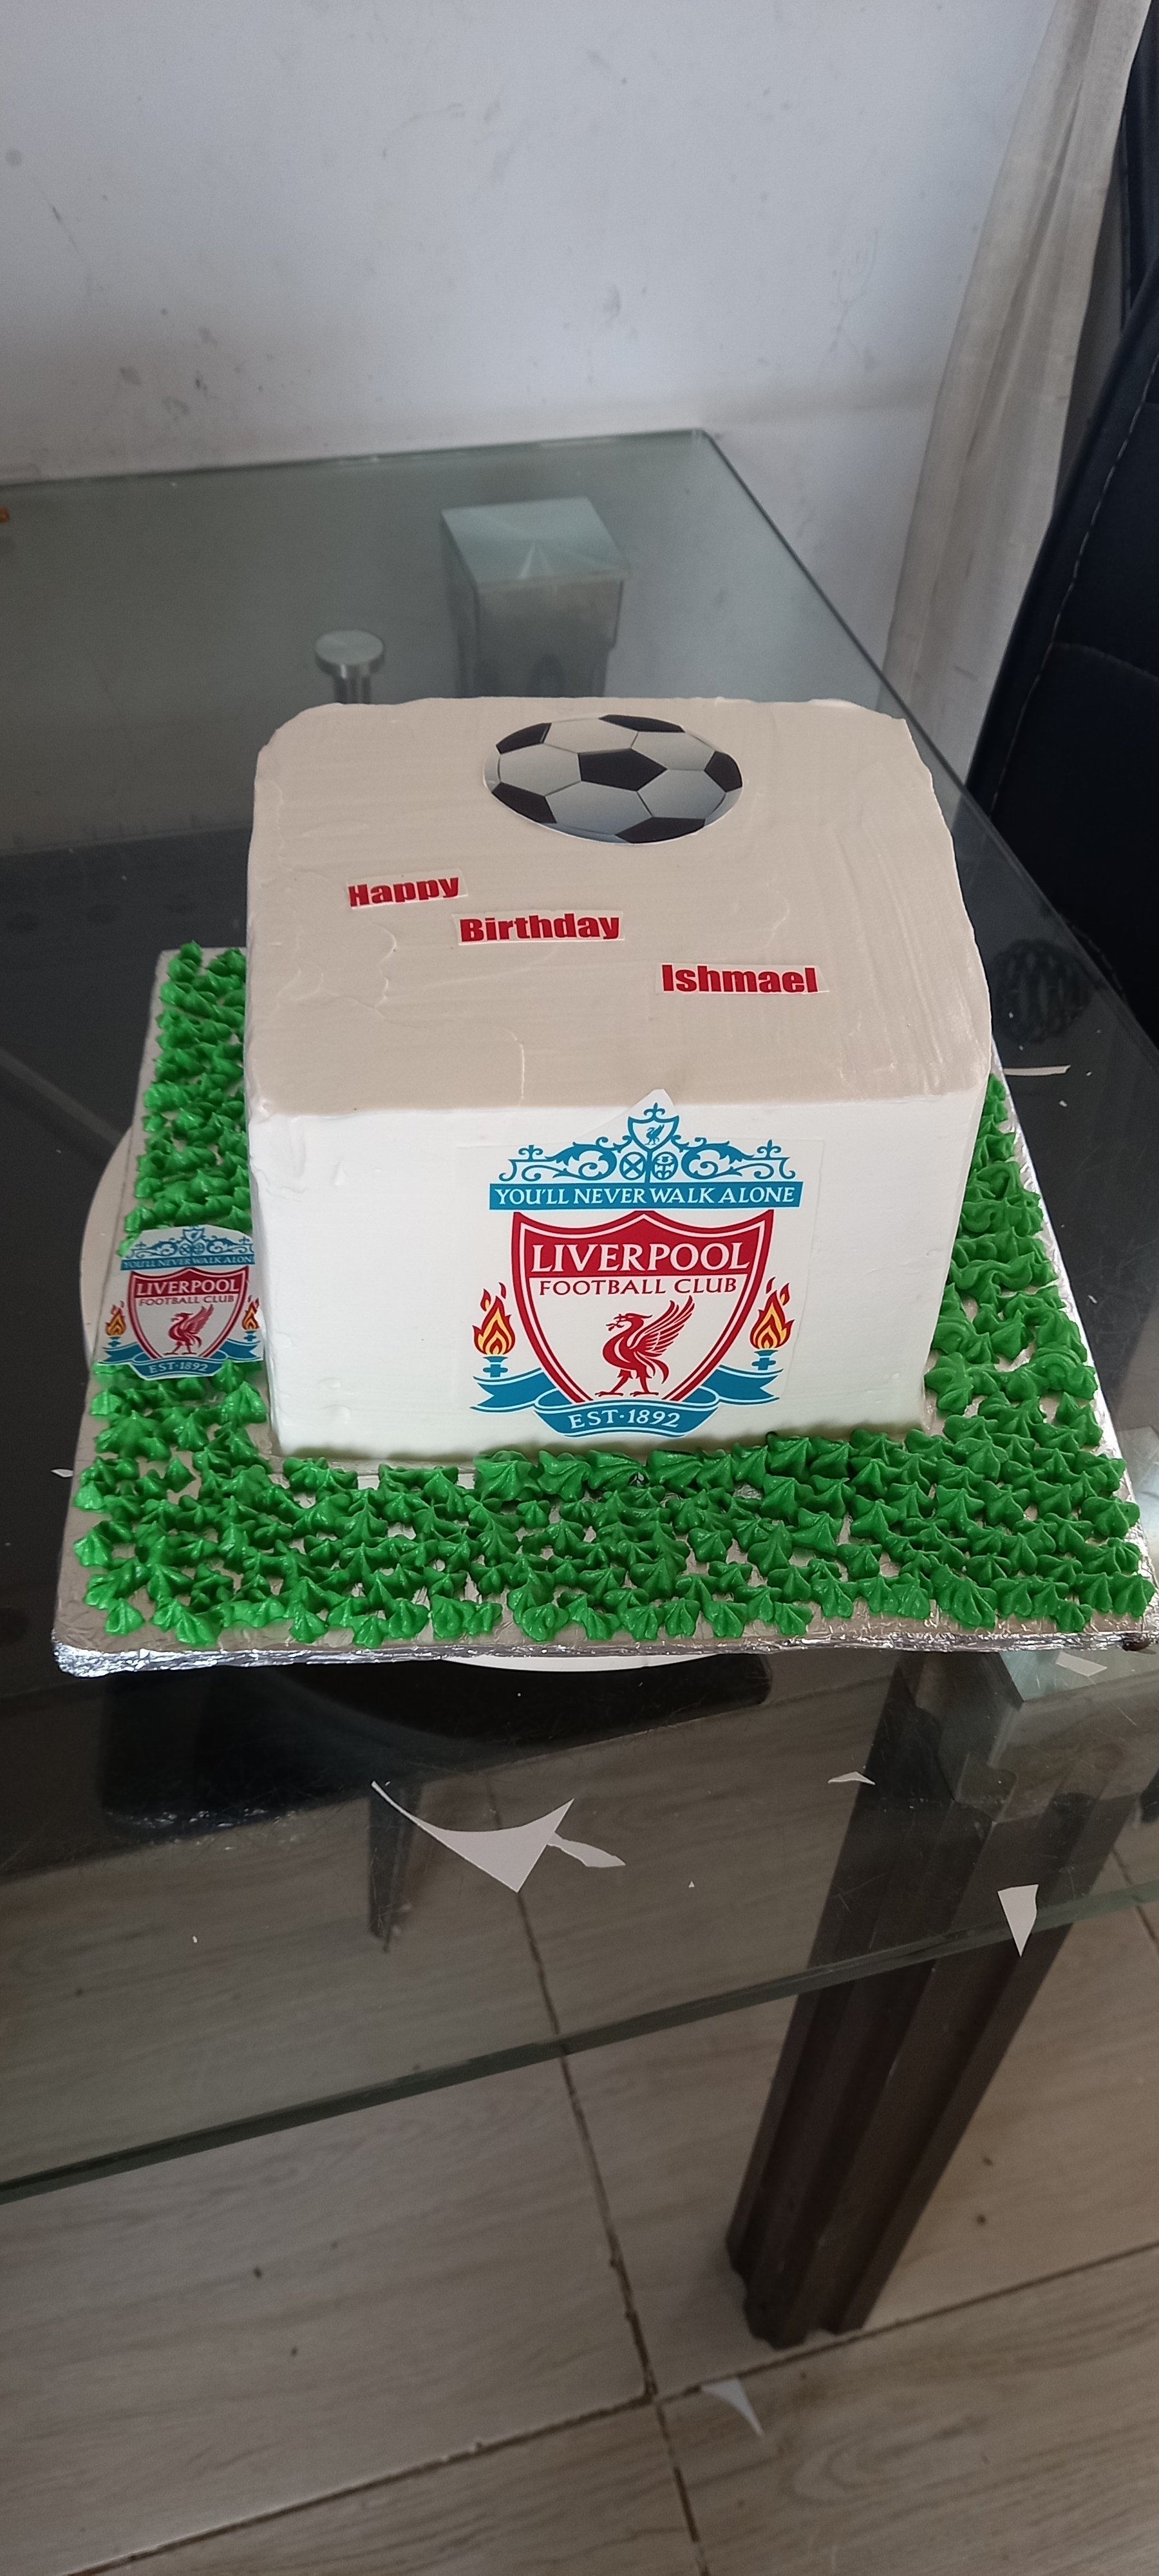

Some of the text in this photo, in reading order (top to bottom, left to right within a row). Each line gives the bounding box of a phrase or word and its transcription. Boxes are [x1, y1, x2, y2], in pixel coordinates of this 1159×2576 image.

[348, 876, 459, 907] Happy
[459, 913, 619, 942] Birthday
[661, 964, 817, 993] Ishmael
[495, 1186, 795, 1204] YOU'LL NEVER WALK ALONE
[192, 1256, 221, 1265] WALK
[531, 1242, 749, 1273] LIVERPOOL
[137, 1278, 240, 1296] LIVERPOOL
[539, 1278, 737, 1296] FOOTBALL CLUB
[138, 1295, 234, 1306] FOOTBALL CLUB
